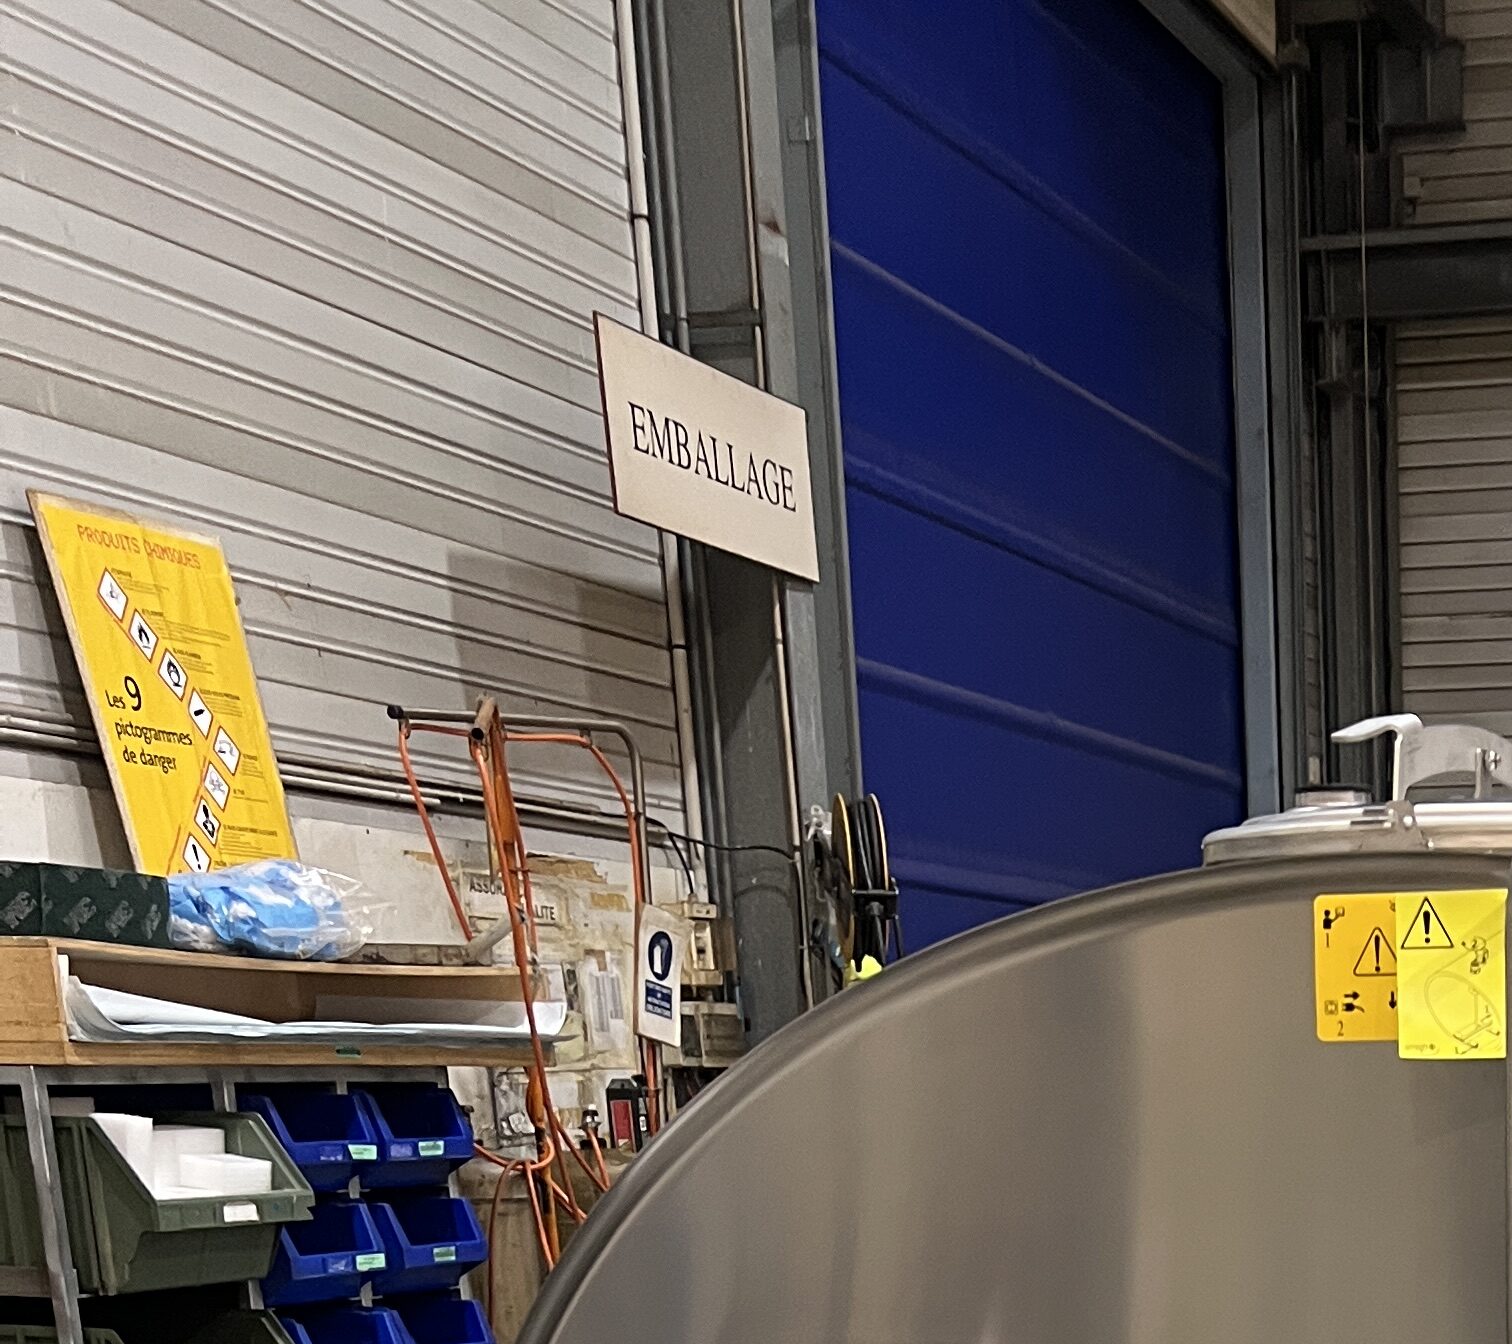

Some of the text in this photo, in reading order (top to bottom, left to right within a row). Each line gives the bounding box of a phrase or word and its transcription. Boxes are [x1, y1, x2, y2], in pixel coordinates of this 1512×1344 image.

[628, 401, 796, 513] EMBALLAGE
[77, 524, 140, 554] PRODUITS
[105, 676, 142, 711] Les 9
[115, 718, 192, 745] pictogrammes
[123, 745, 176, 774] de danger
[1337, 1019, 1344, 1037] 2
